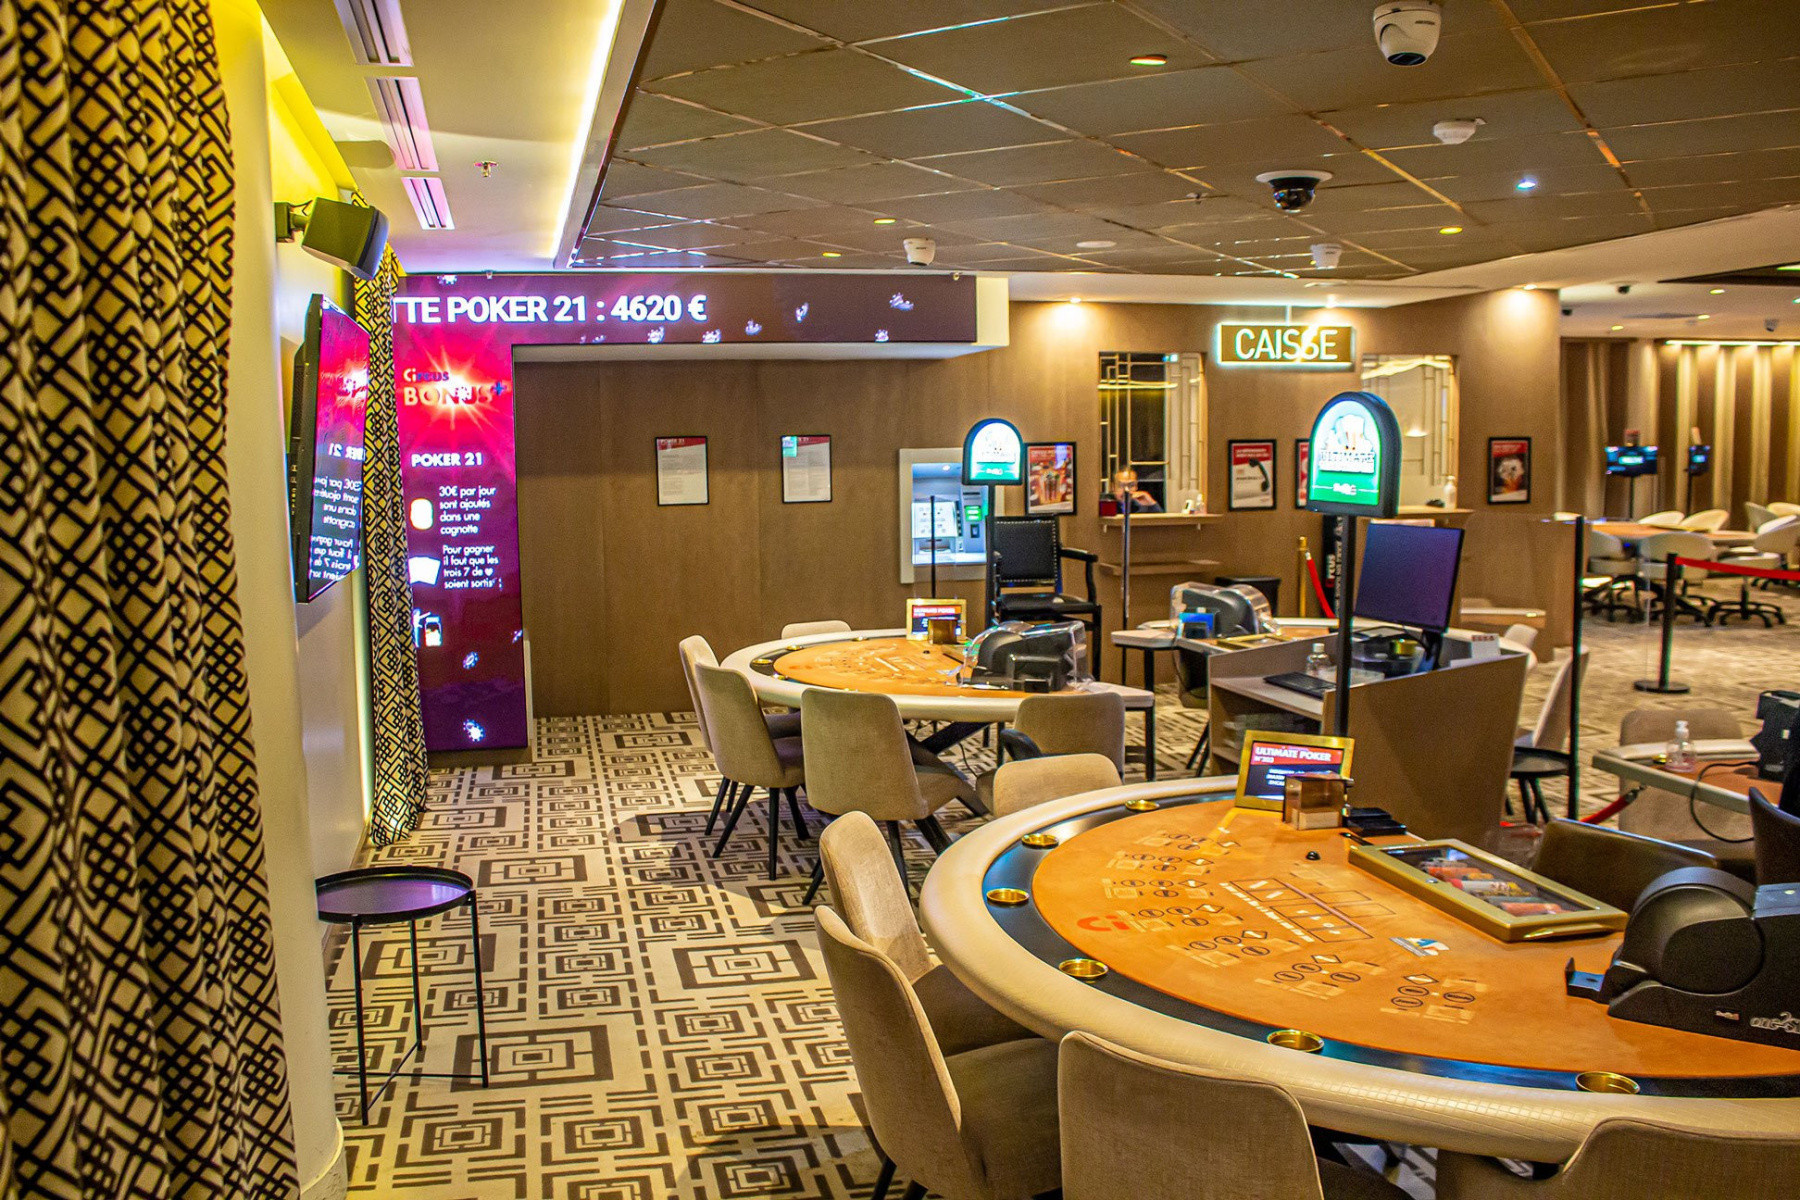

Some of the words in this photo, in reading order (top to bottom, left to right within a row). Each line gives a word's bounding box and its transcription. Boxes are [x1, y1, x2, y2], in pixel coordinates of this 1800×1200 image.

[447, 295, 549, 323] POKER
[553, 295, 587, 322] 21
[610, 295, 682, 322] 4620
[688, 294, 708, 322] €
[1235, 328, 1338, 360] CAISSE
[403, 368, 449, 382] Circus
[411, 453, 461, 467] POKER
[464, 452, 482, 466] 21
[439, 486, 458, 497] 30€
[460, 488, 476, 498] par
[478, 485, 496, 498] jour
[439, 500, 458, 509] sont
[460, 499, 491, 511] ajoutés
[440, 511, 462, 522] dans
[464, 513, 481, 522] une
[440, 524, 479, 536] cagnotte
[442, 545, 462, 555] Pour
[463, 546, 495, 556] gagner
[443, 555, 449, 565] il
[450, 555, 467, 565] faut
[469, 556, 485, 567] que
[487, 554, 499, 564] les
[443, 567, 462, 577] trois
[463, 567, 470, 577] 7
[472, 566, 484, 576] de
[444, 577, 469, 588] soient
[471, 577, 494, 588] sortis
[1256, 747, 1298, 758] ULTIMATE
[1299, 750, 1331, 761] POKER
